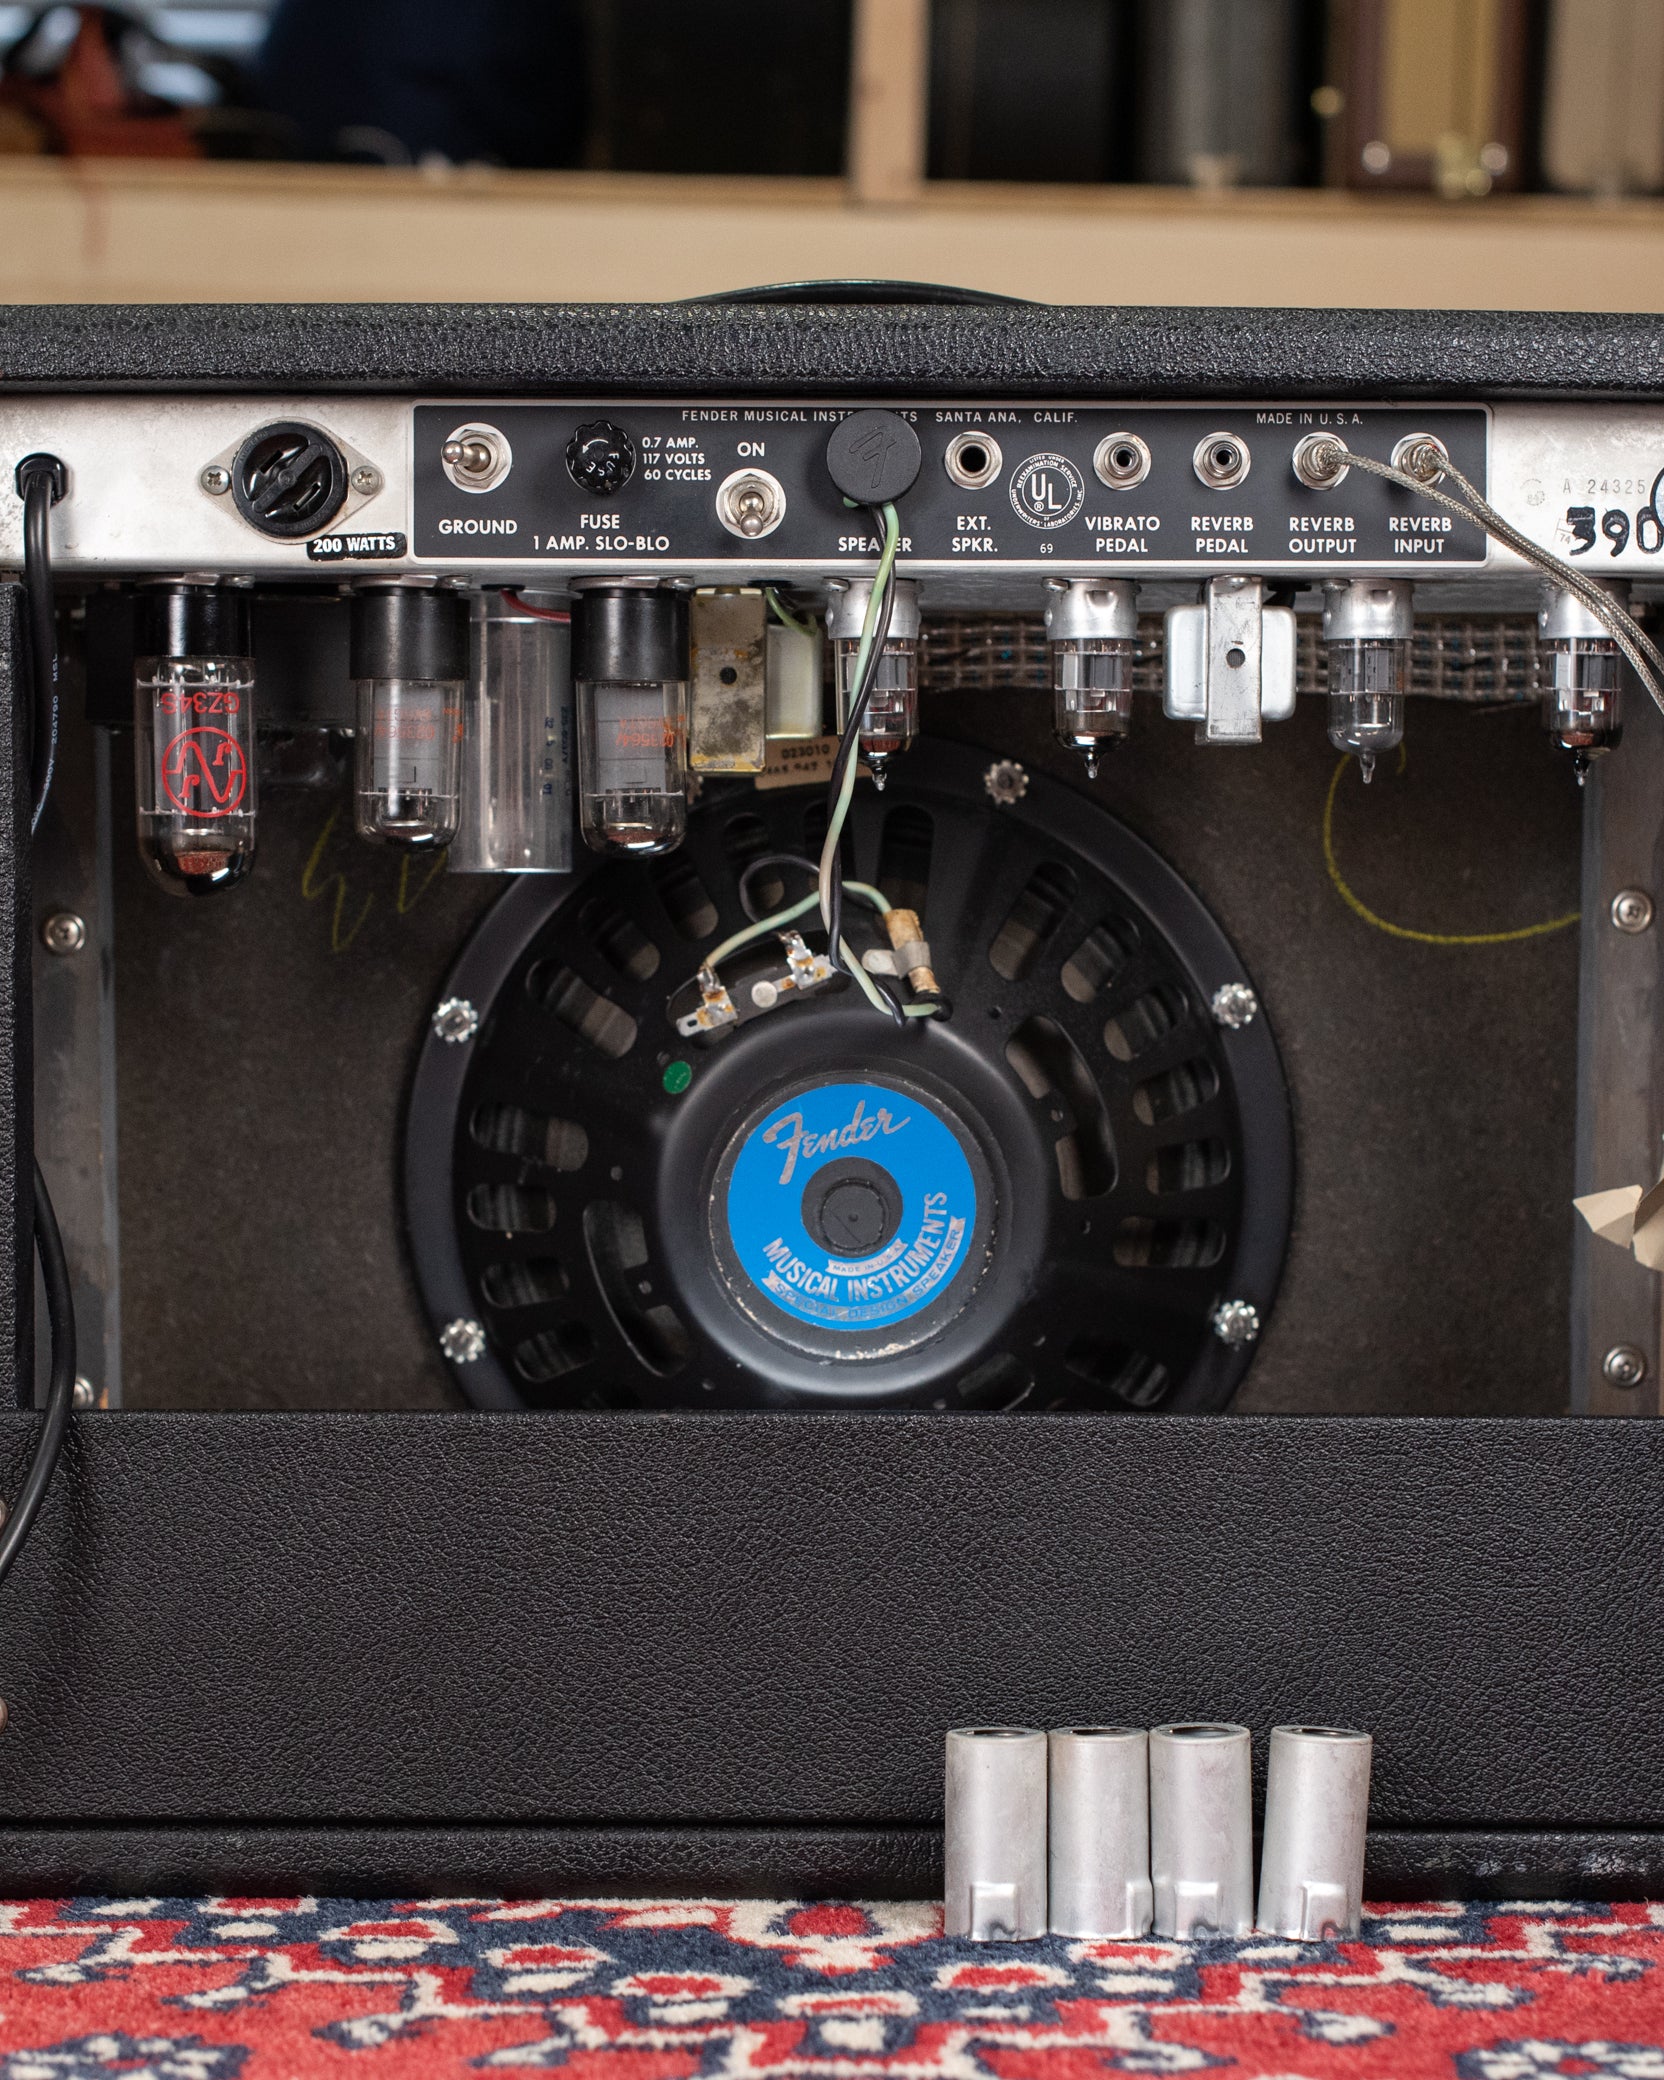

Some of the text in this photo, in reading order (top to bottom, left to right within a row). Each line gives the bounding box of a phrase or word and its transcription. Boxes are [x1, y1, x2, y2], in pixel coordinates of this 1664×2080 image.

[682, 410, 1078, 424] FENDER MUSICAL INSTTS SANTA ANA, CALIF.
[1256, 412, 1292, 425] MADE
[1299, 412, 1312, 425] IN
[642, 436, 699, 449] 0.7 AMP.
[737, 442, 765, 457] ON
[642, 453, 705, 465] 117 VOLTS
[644, 468, 712, 481] 60 CYCLES
[1032, 473, 1062, 510] UL
[1587, 479, 1646, 495] 24325
[438, 519, 518, 535] GROUND
[580, 514, 620, 529] FUSE
[956, 515, 992, 531] EXT.
[1084, 516, 1160, 531] VIBRATO
[1191, 516, 1254, 532] REVERB
[1289, 517, 1355, 532] REVERB
[1389, 517, 1452, 532] REVERB
[313, 536, 396, 553] 200 WATTS
[533, 535, 670, 551] 1 AMP. SLO-BLO
[838, 536, 912, 552] SPEAER
[951, 537, 998, 553] SPKR.
[1039, 543, 1054, 554] 69
[1095, 538, 1148, 553] PEDAL
[1195, 538, 1249, 553] PEDAL
[1288, 538, 1357, 553] OUTPUT
[1394, 539, 1445, 553] INPUT
[161, 691, 241, 716] GZ34S
[762, 1098, 912, 1185] Fender
[762, 1191, 948, 1303] MUSICAL INSTRUMENTS
[832, 1264, 861, 1273] MADE
[912, 1229, 960, 1297] SPEAKER
